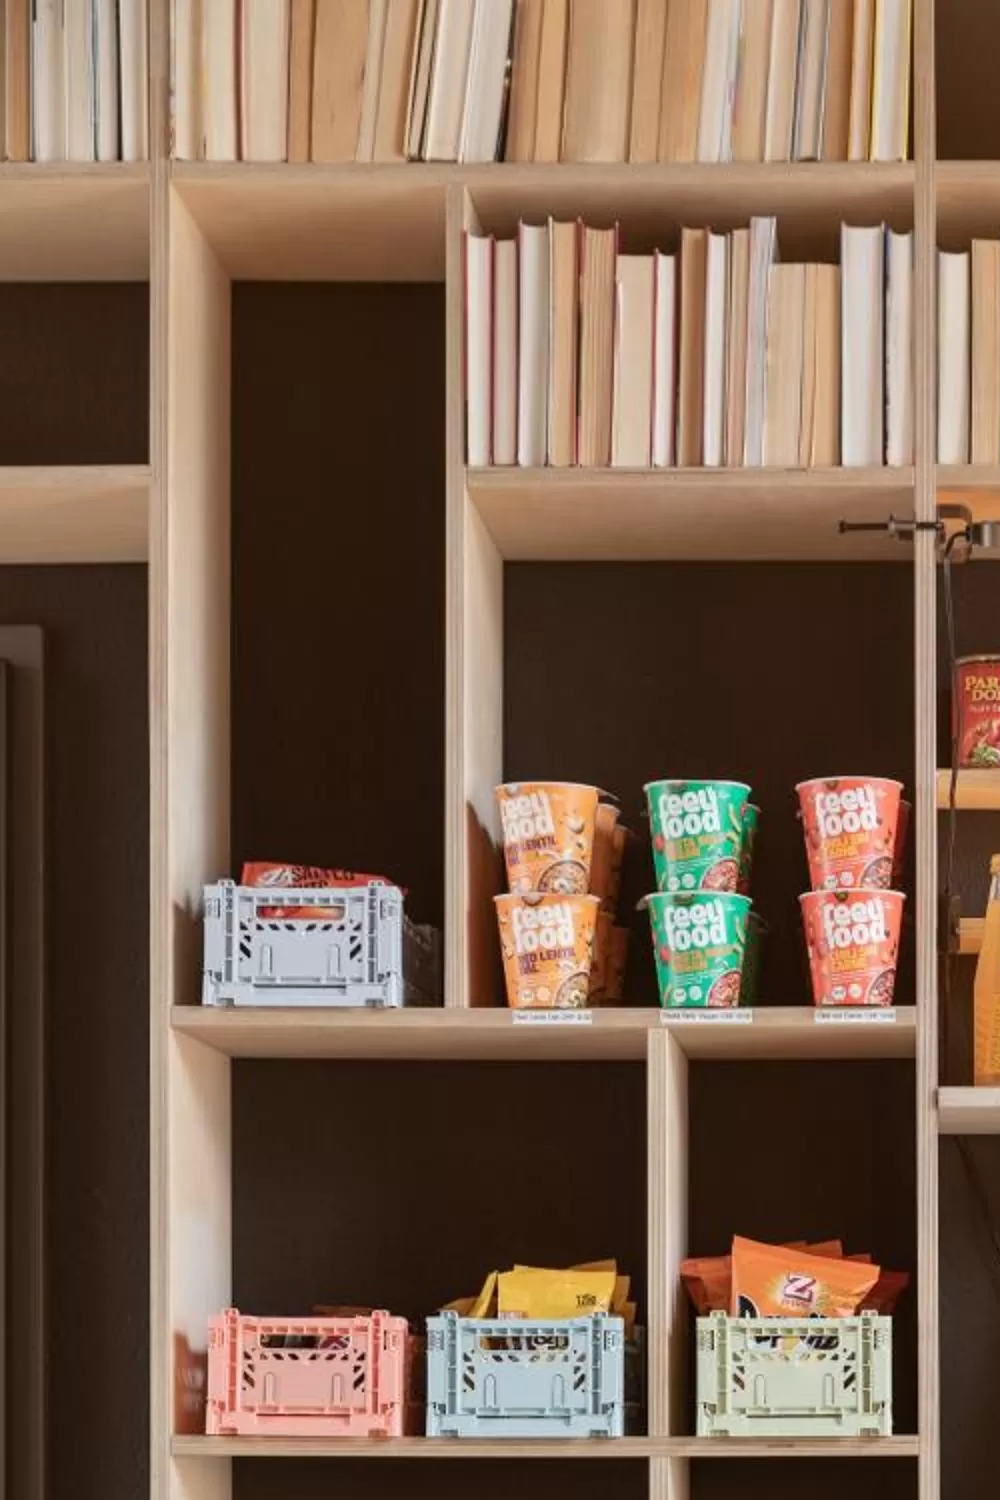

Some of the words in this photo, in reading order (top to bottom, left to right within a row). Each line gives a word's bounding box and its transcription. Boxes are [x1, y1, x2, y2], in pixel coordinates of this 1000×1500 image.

[512, 925, 575, 953] food
[665, 923, 727, 951] food
[824, 921, 888, 949] food
